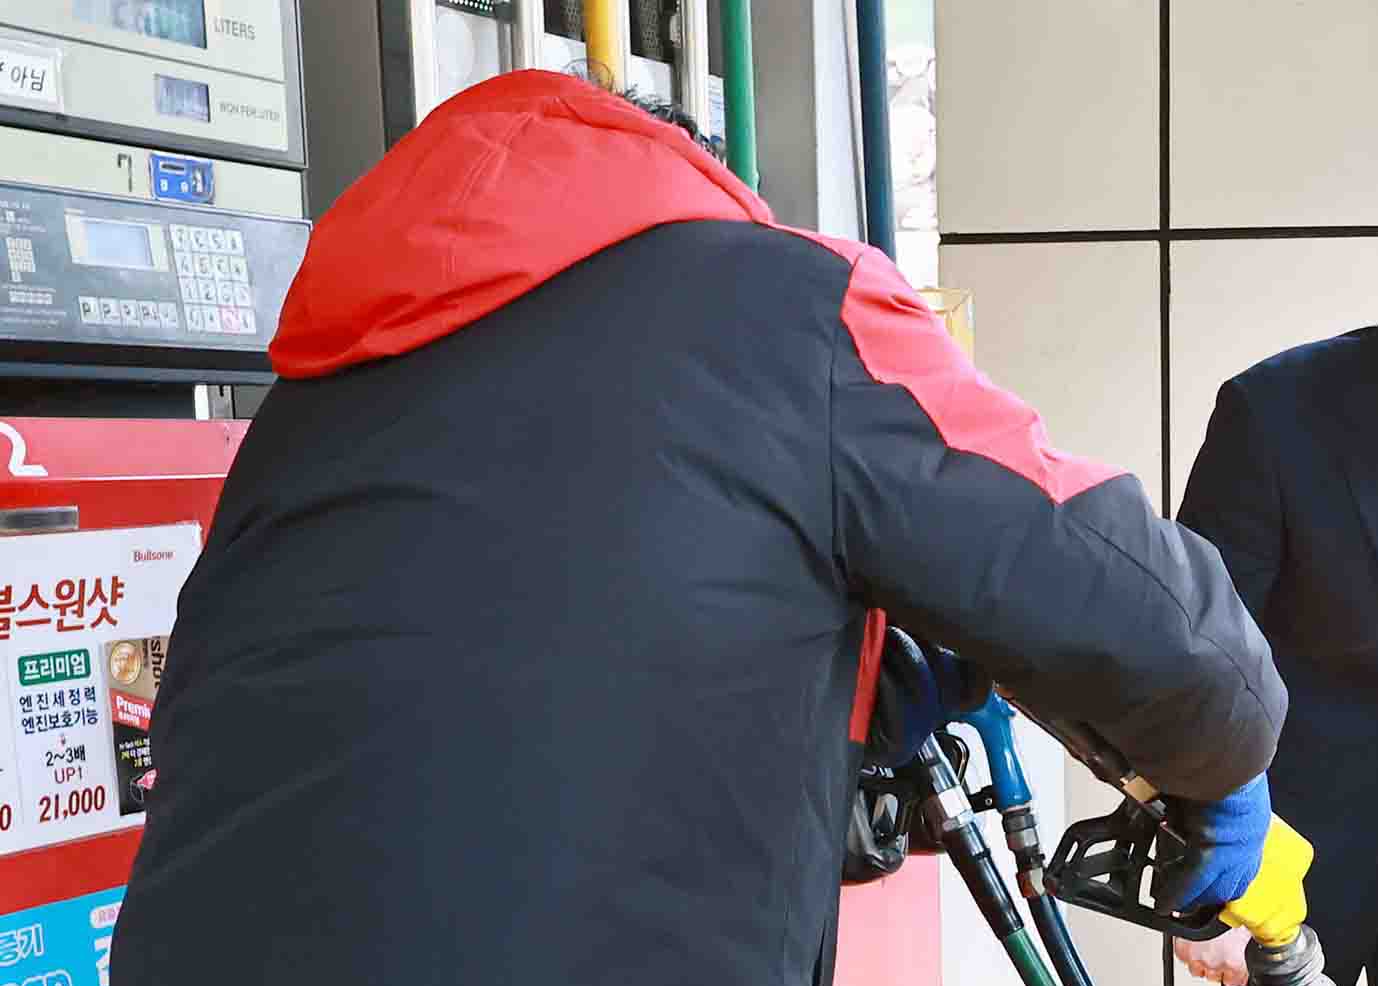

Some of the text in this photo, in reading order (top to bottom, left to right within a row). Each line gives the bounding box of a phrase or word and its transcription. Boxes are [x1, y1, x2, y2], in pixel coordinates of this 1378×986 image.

[213, 17, 256, 40] LITERS
[10, 65, 46, 92] 아님
[134, 549, 174, 562] Bullsone
[24, 652, 86, 681] 프리미엄
[21, 706, 99, 735] 엔진보호기능
[45, 743, 86, 767] 2~3배
[39, 785, 106, 823] 21,000
